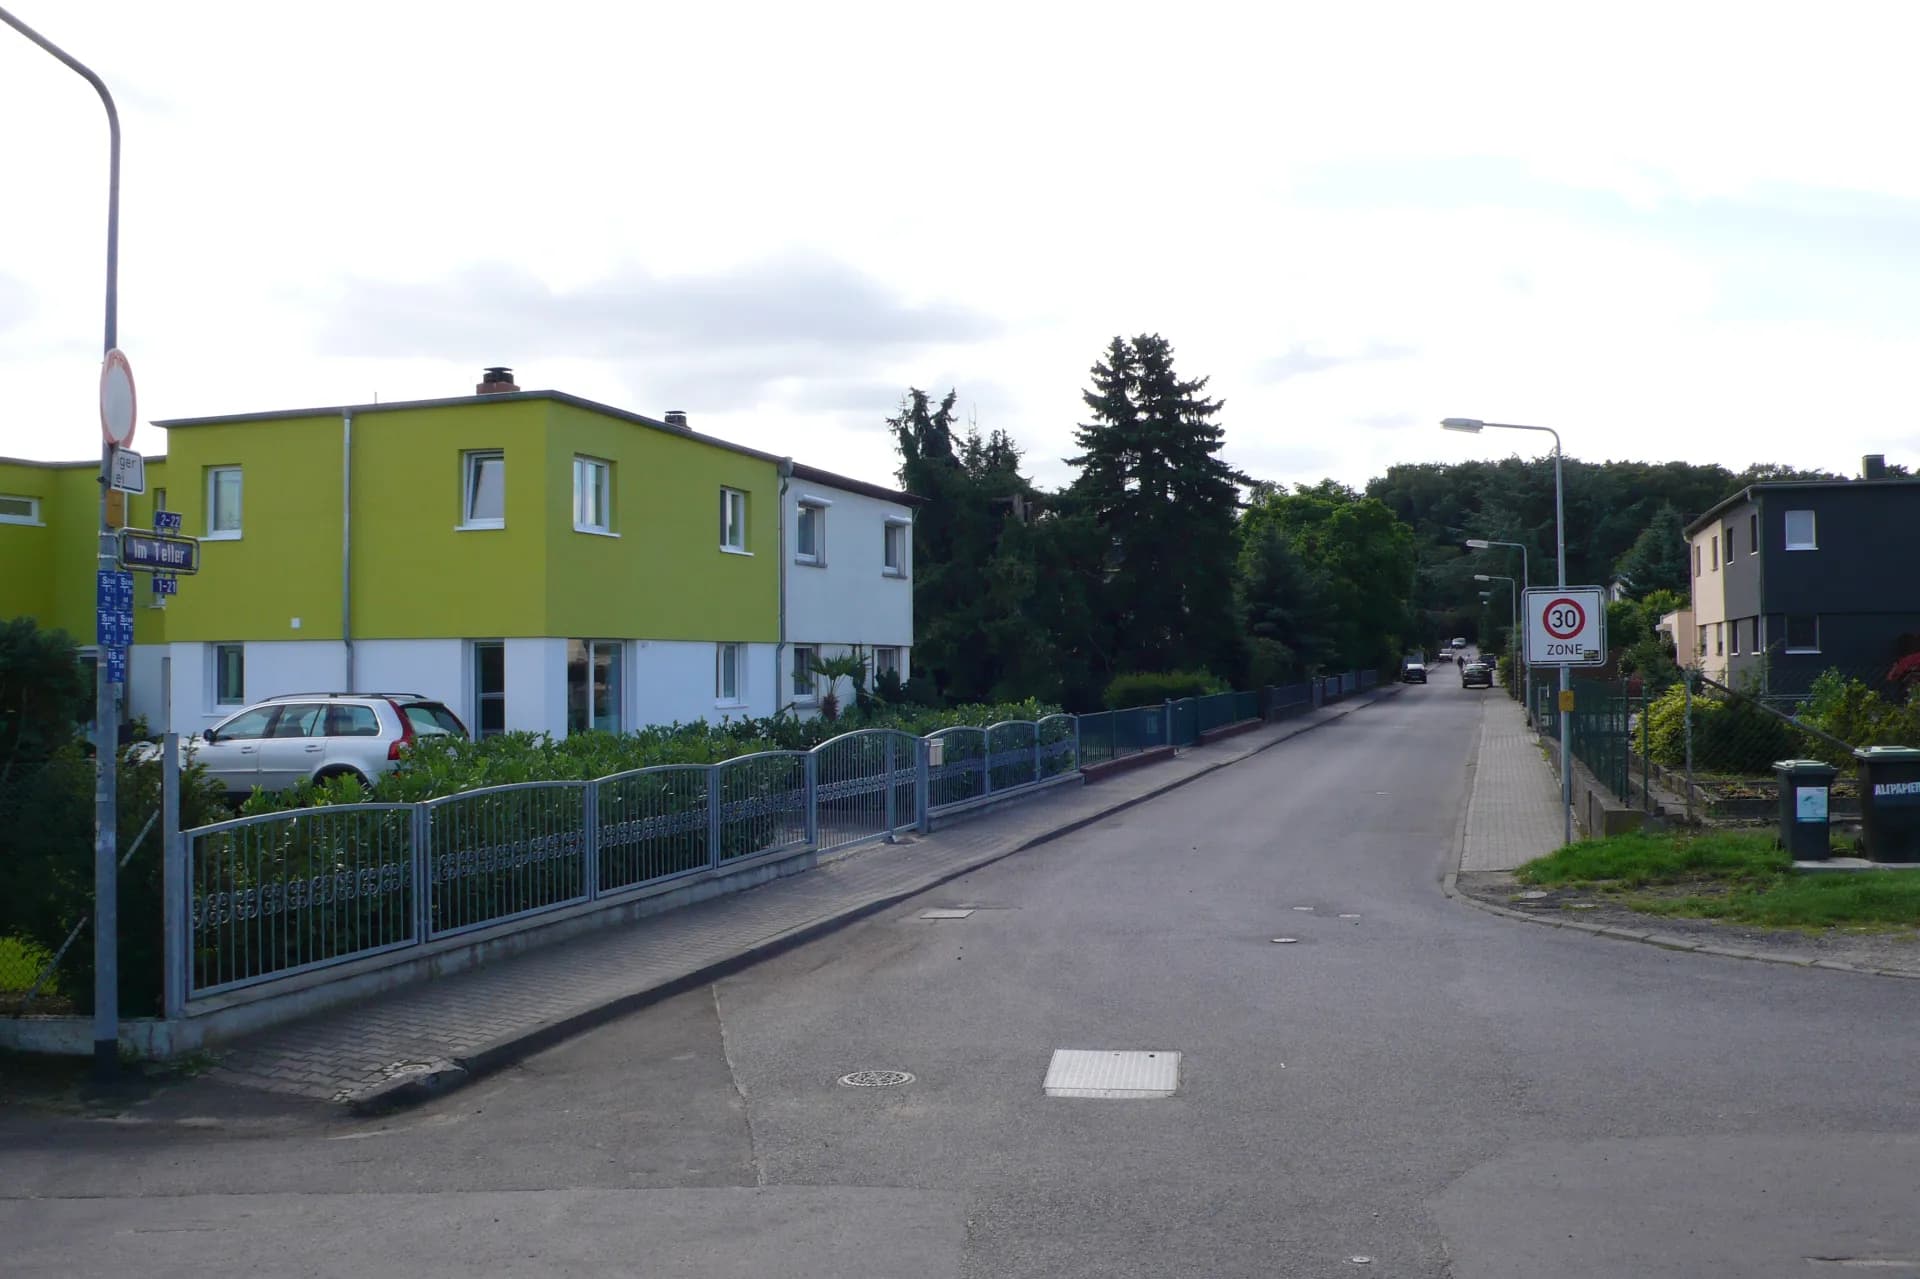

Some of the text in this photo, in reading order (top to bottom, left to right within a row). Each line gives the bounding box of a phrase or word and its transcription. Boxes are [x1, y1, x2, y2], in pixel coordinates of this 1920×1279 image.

[160, 514, 180, 528] 2-22
[134, 540, 184, 564] Im Teller
[158, 579, 176, 593] 1-21
[1552, 609, 1576, 628] 30
[1547, 644, 1583, 656] ZONE
